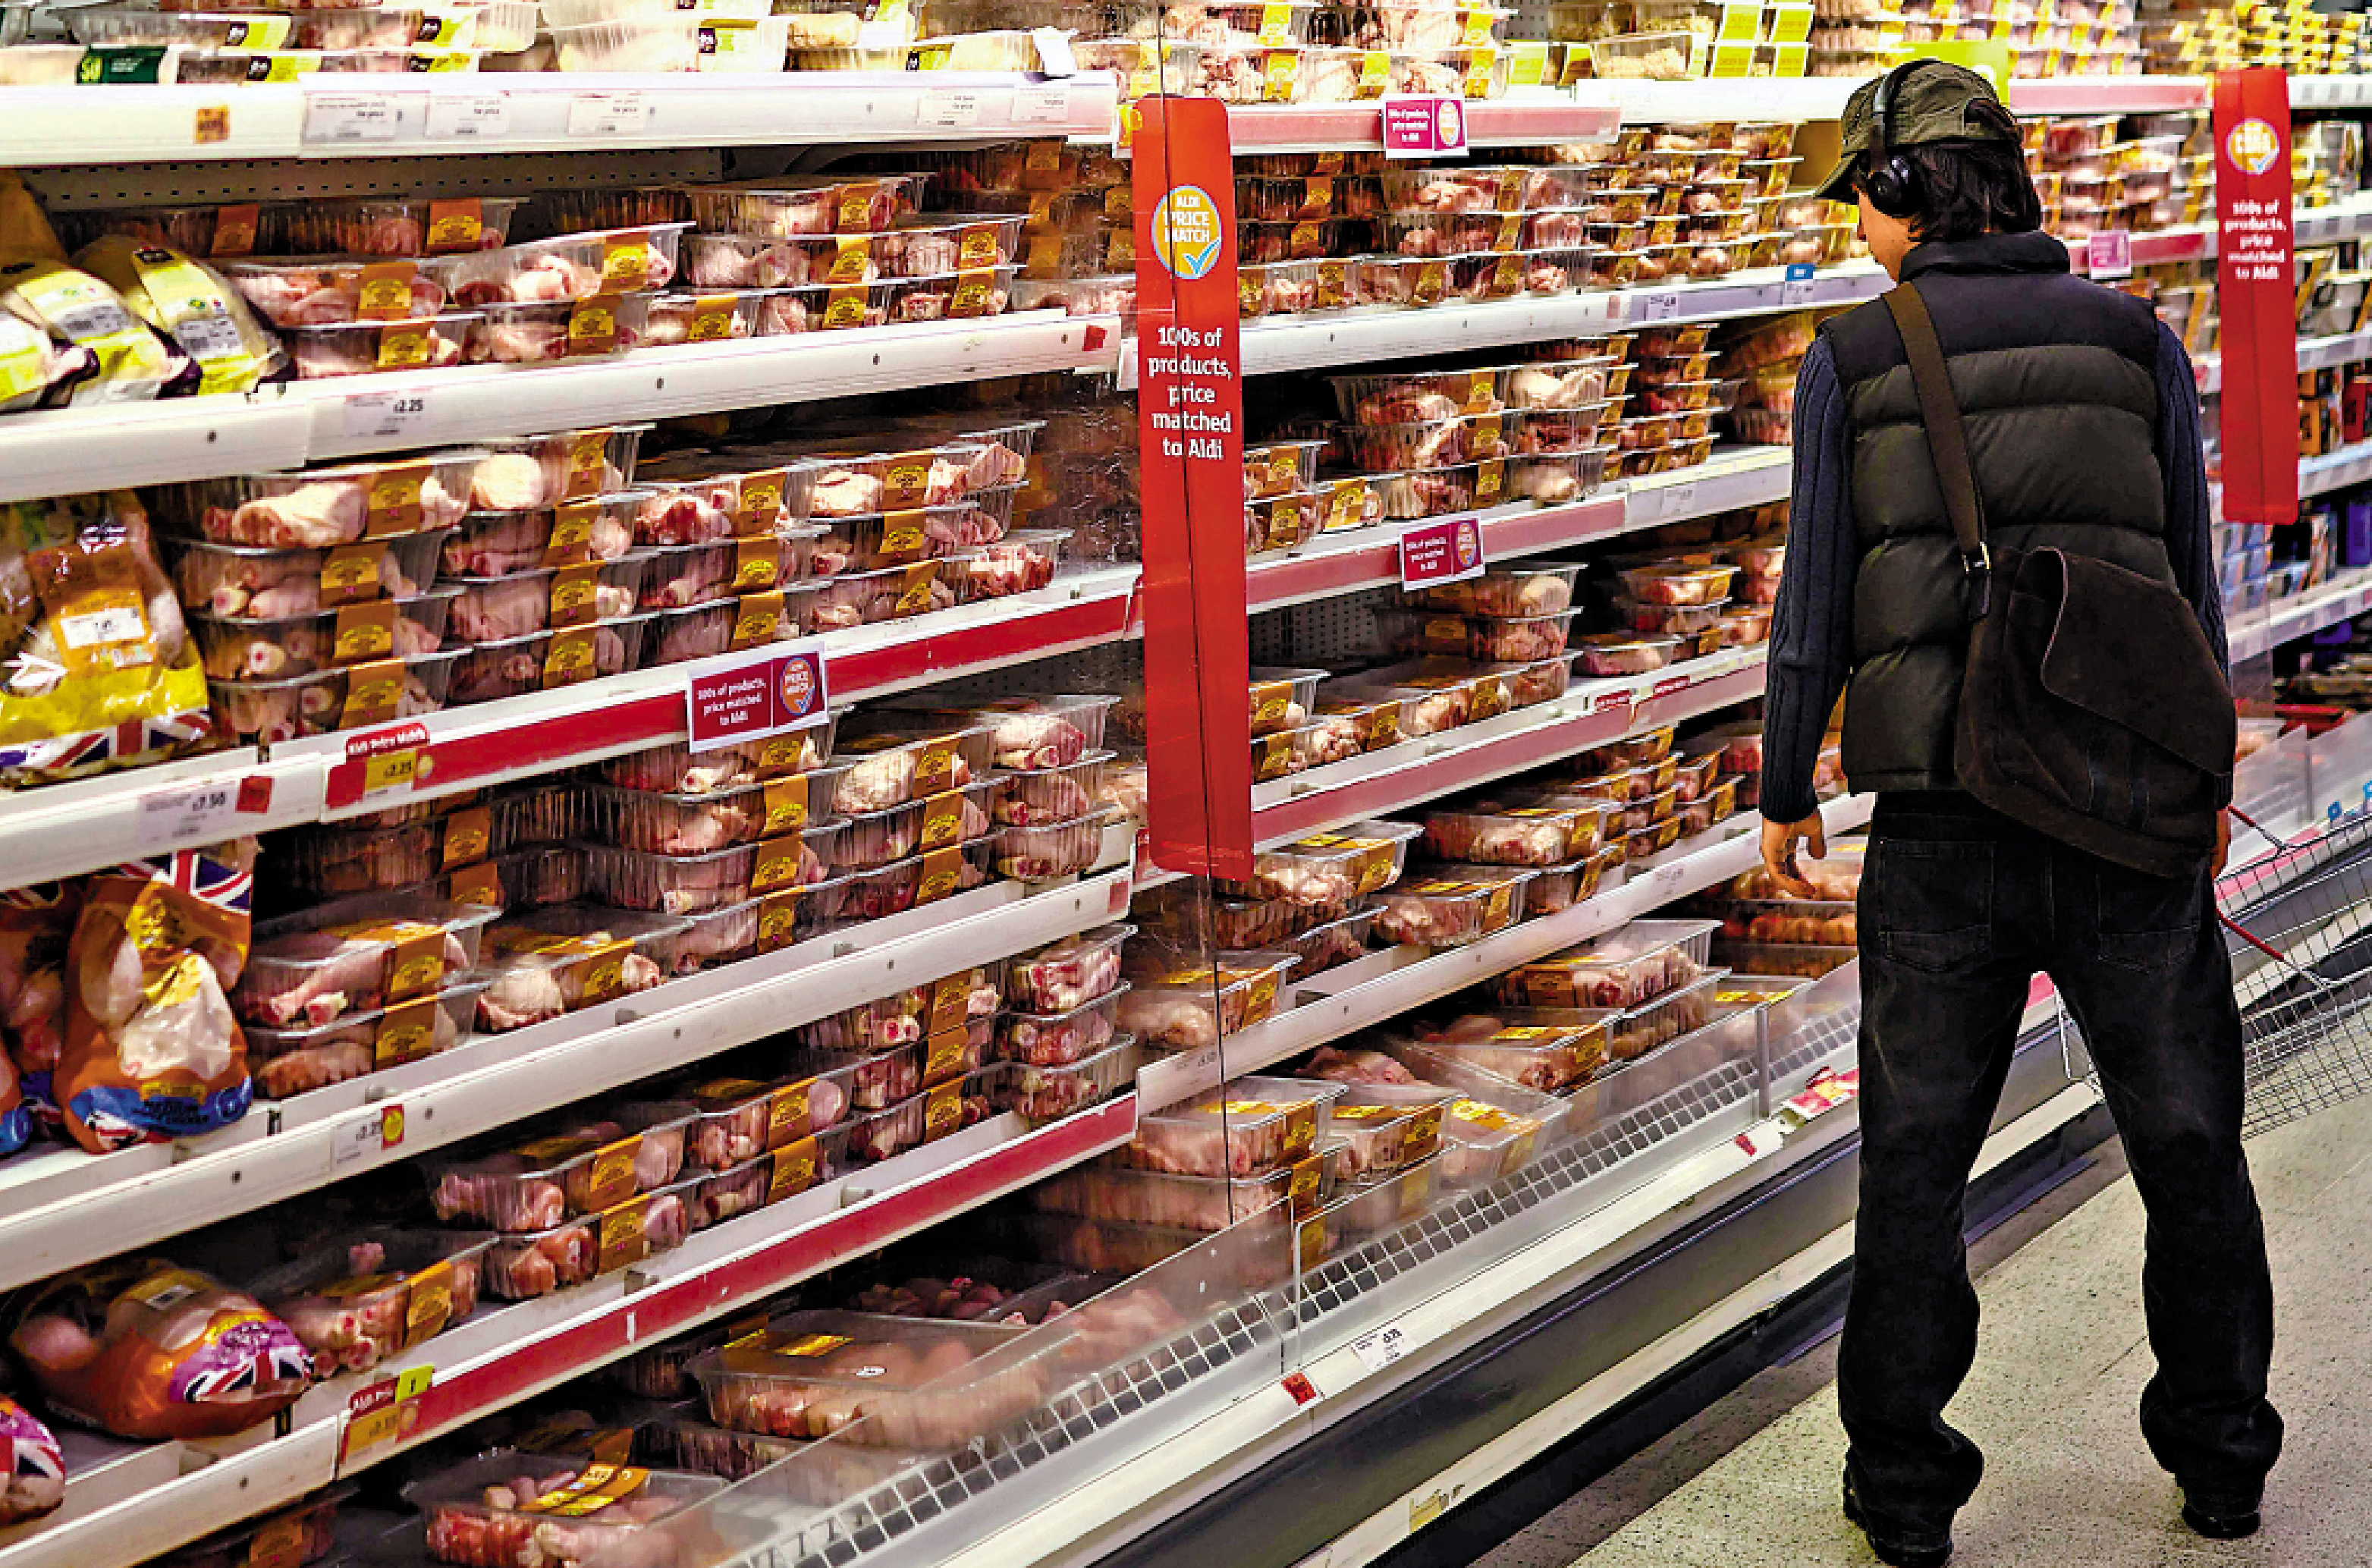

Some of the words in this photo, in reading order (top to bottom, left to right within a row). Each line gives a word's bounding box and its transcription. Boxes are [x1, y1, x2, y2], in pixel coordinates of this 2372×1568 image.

[1158, 326, 1200, 347] 100s
[1204, 327, 1224, 347] of
[1147, 354, 1233, 381] products,
[1167, 381, 1217, 407] price
[1151, 410, 1232, 433] matched
[1162, 437, 1183, 457] to
[1188, 437, 1224, 460] Aldi
[717, 683, 727, 696] of
[728, 677, 767, 698] products,
[703, 702, 725, 718] price
